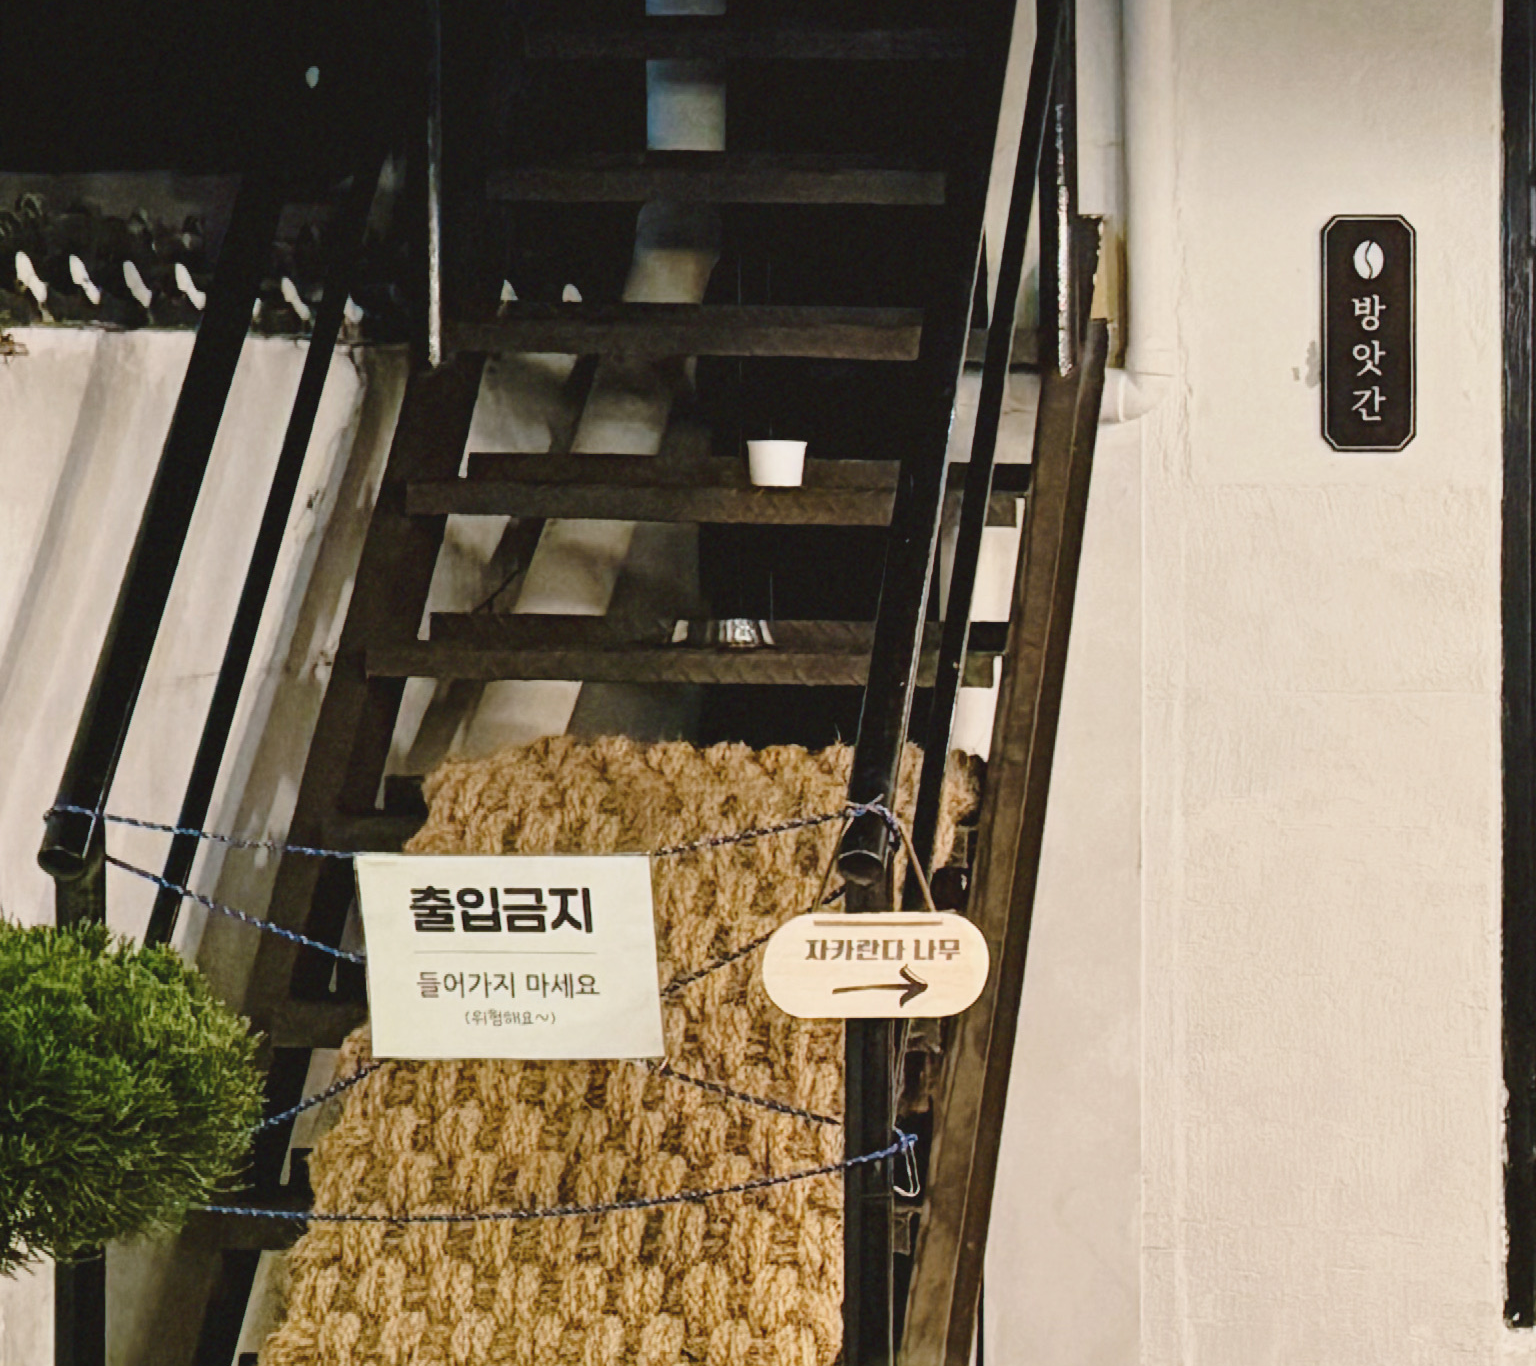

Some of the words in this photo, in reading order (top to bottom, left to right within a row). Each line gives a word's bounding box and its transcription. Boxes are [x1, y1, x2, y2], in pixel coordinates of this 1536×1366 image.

[1351, 293, 1387, 422] 방앗간
[409, 885, 594, 934] 출입금지
[805, 938, 906, 961] 자카란다
[913, 938, 961, 961] 나무
[417, 971, 516, 999] 들어가지
[526, 972, 600, 999] 마세요
